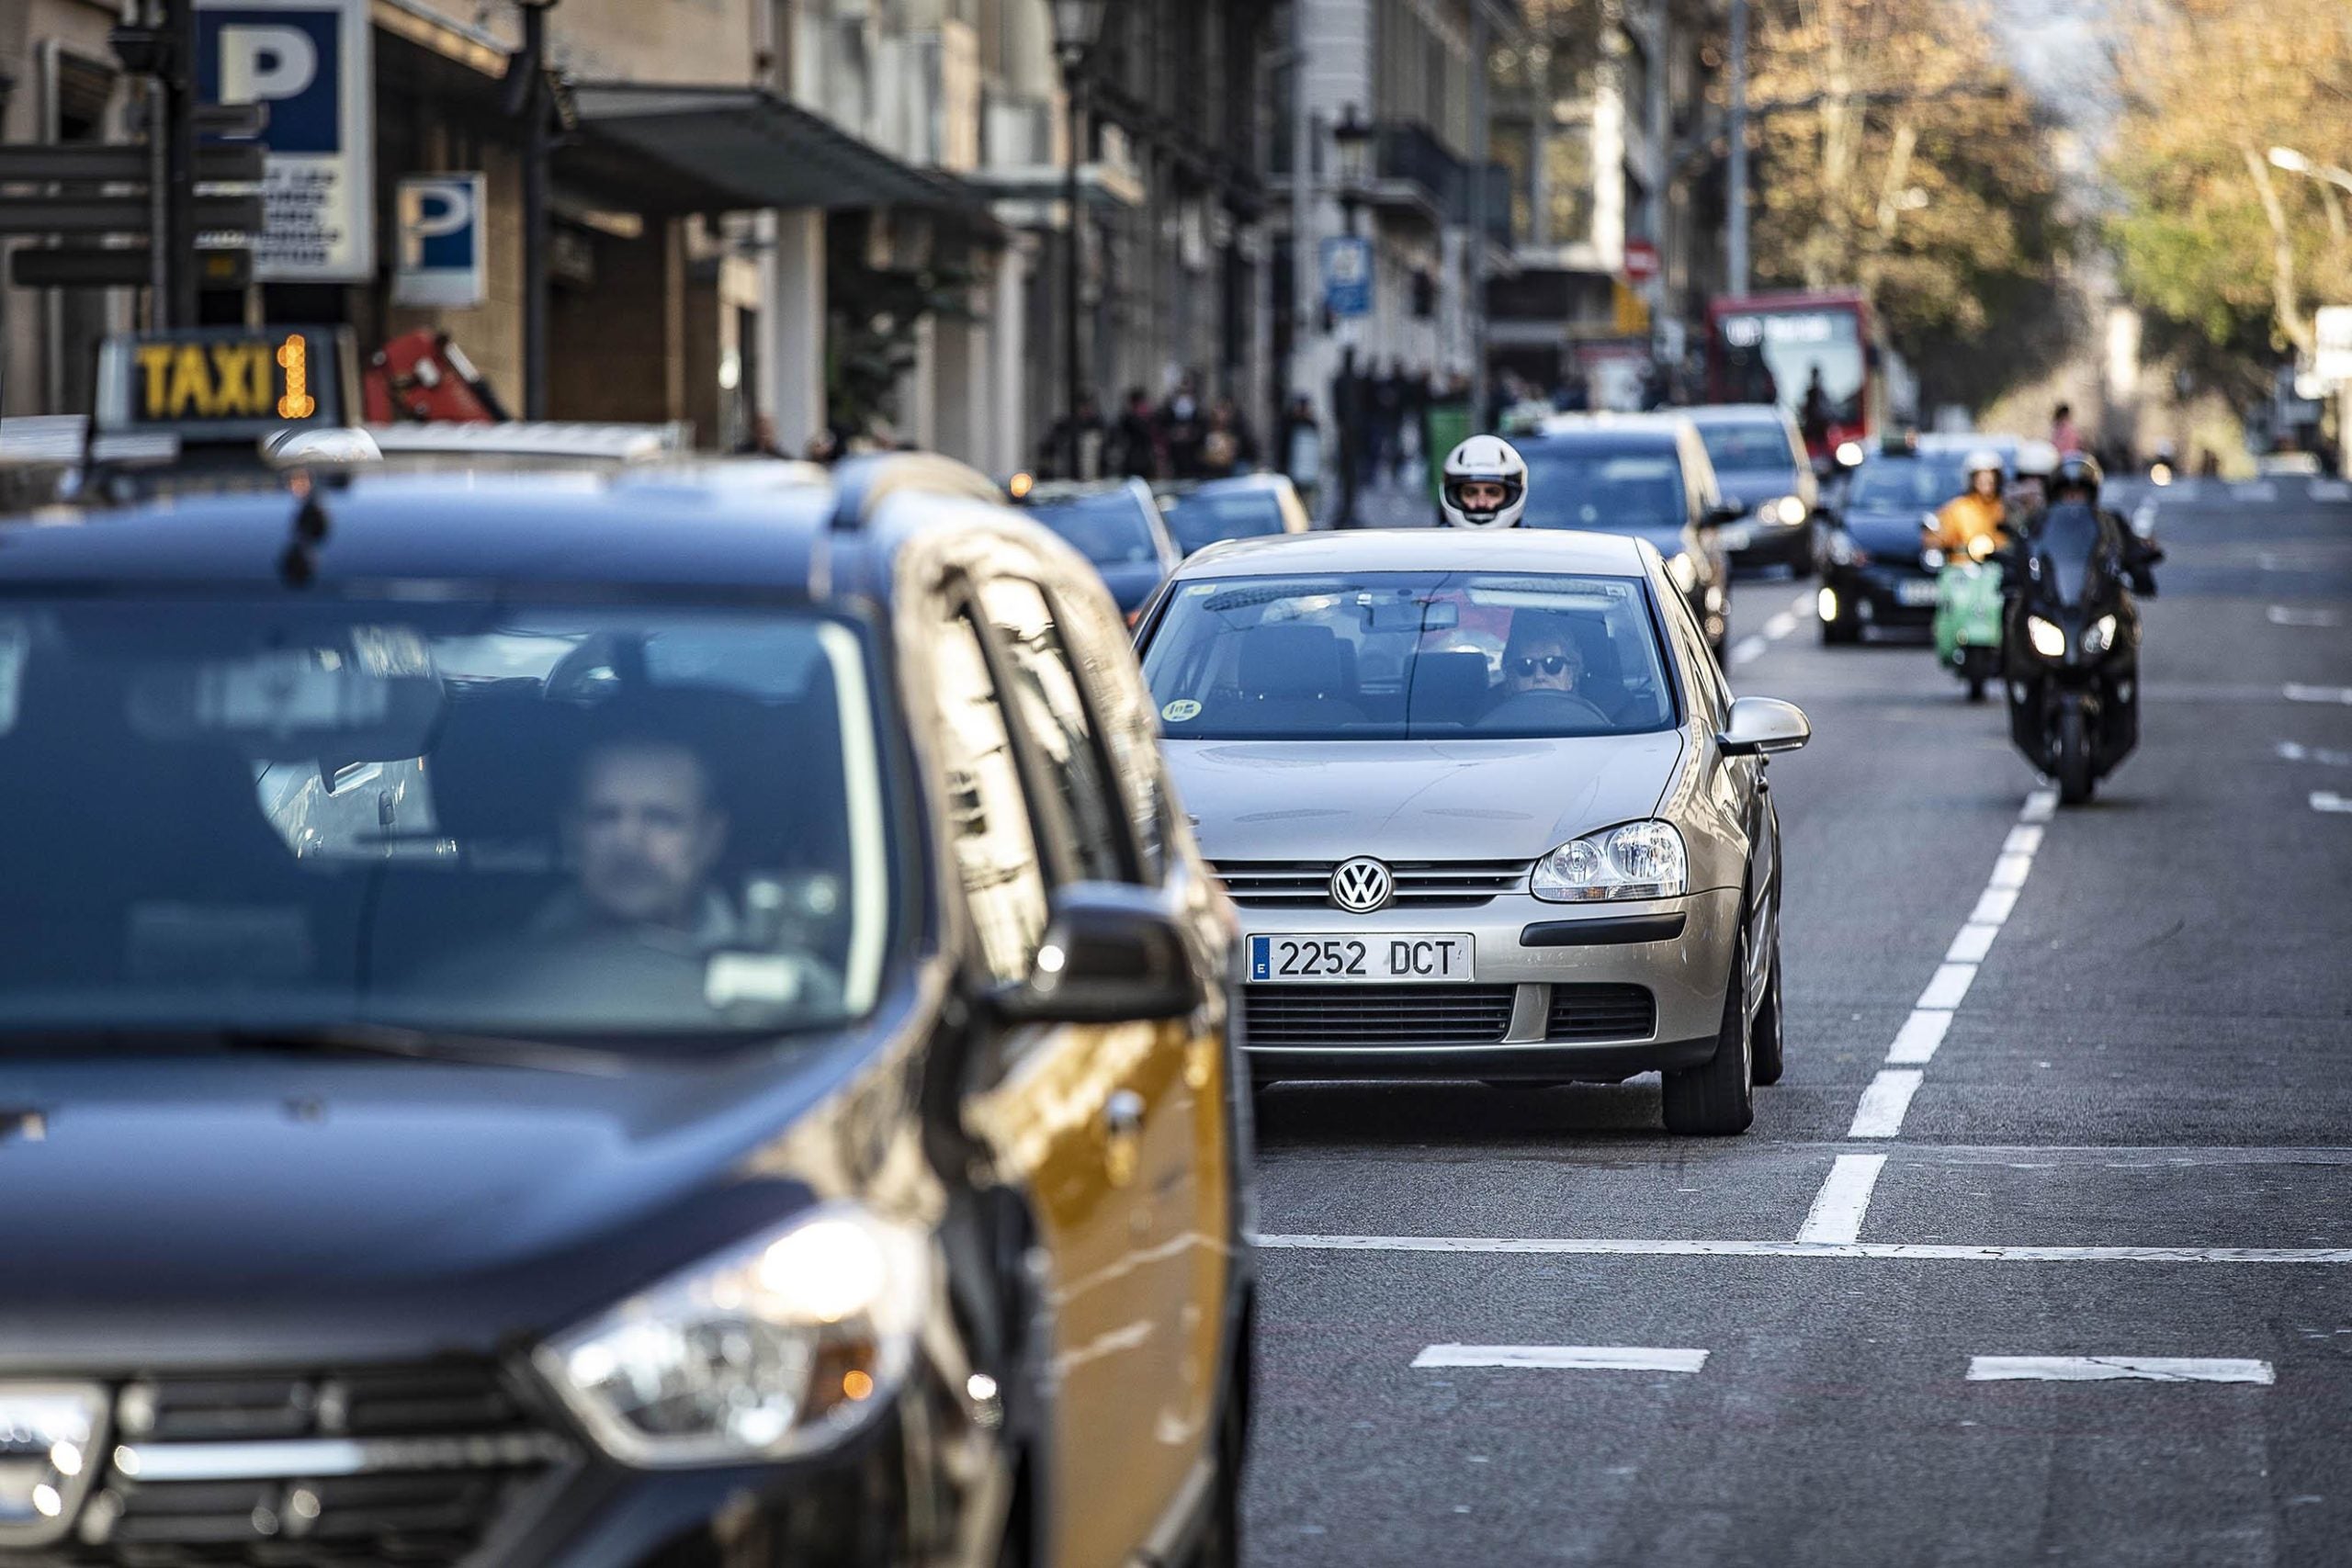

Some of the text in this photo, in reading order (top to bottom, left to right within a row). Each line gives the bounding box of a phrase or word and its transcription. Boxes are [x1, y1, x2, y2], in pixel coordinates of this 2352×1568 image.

[217, 24, 319, 139] P
[398, 186, 468, 266] P
[135, 333, 315, 419] TAXI 1
[1257, 964, 1265, 974] E
[1279, 941, 1455, 975] 2252 DCT
